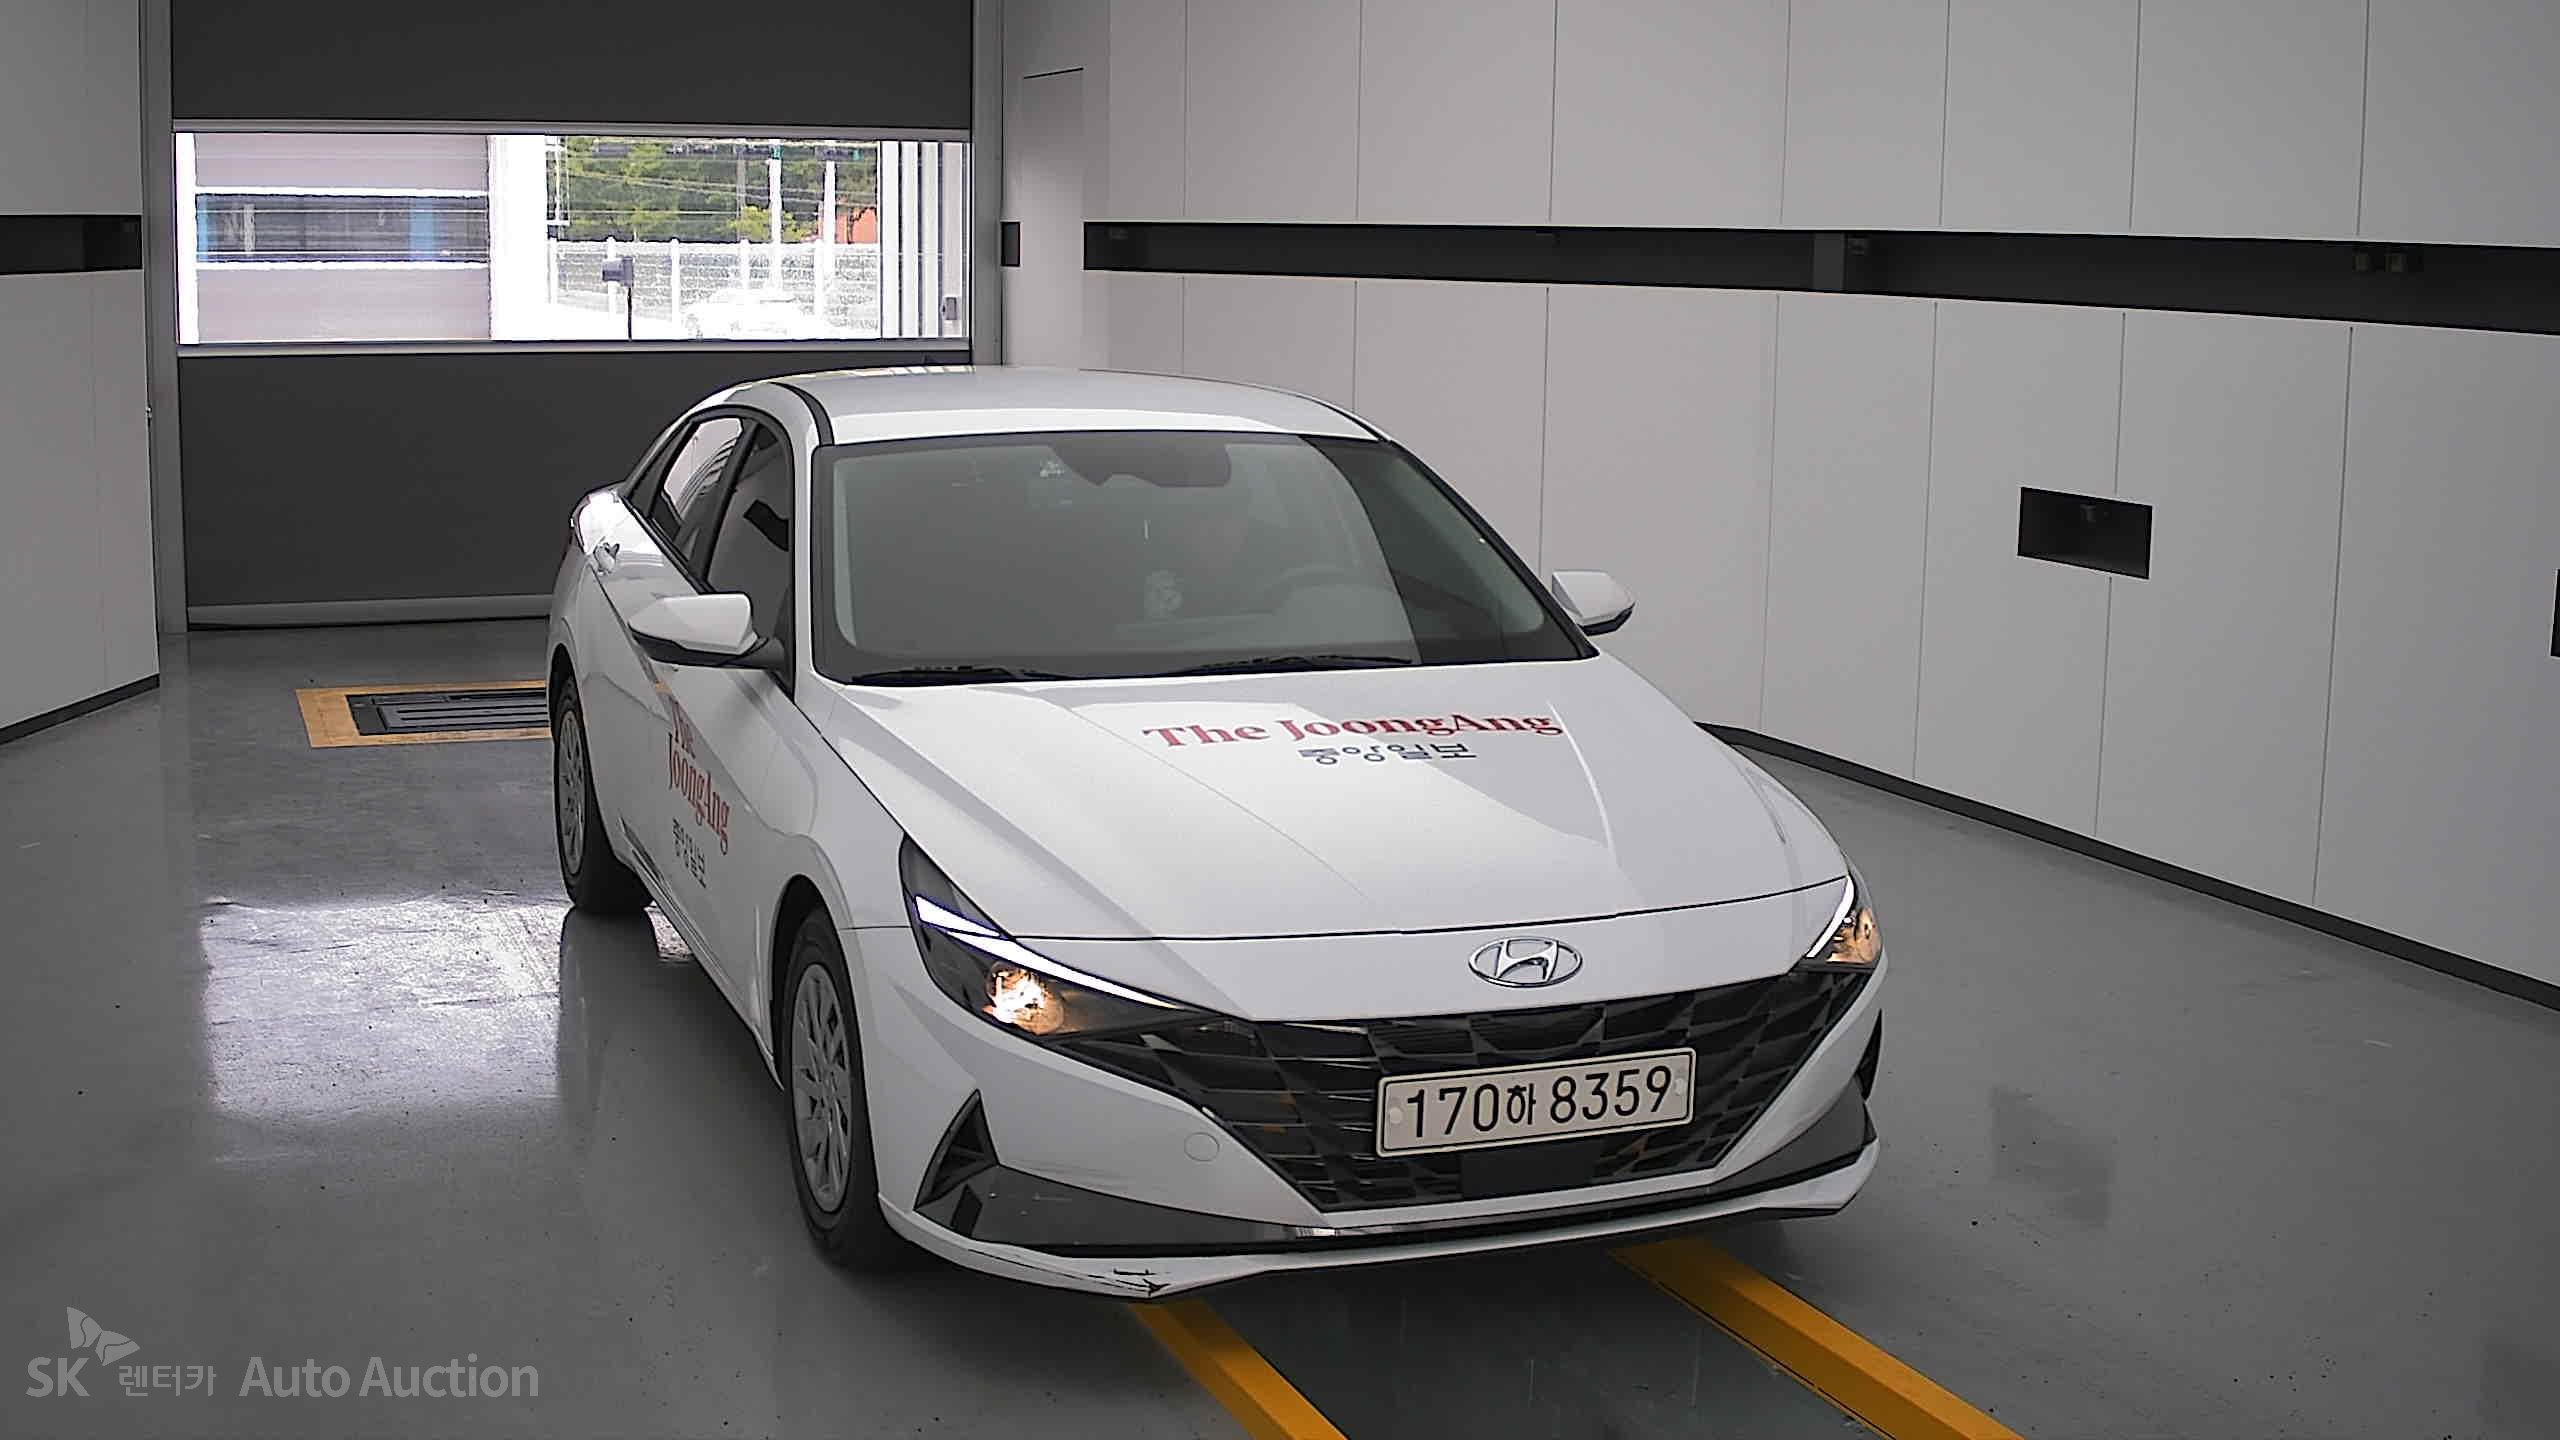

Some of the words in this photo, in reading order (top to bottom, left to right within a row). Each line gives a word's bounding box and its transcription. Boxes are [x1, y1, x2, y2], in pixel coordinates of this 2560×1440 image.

[1143, 725, 1268, 747] The
[1275, 713, 1565, 743] JoongAng
[1298, 742, 1477, 765] 중앙일보
[668, 732, 731, 856] JoongAng
[1407, 1083, 1537, 1138] 170하
[1550, 1066, 1672, 1124] 8359
